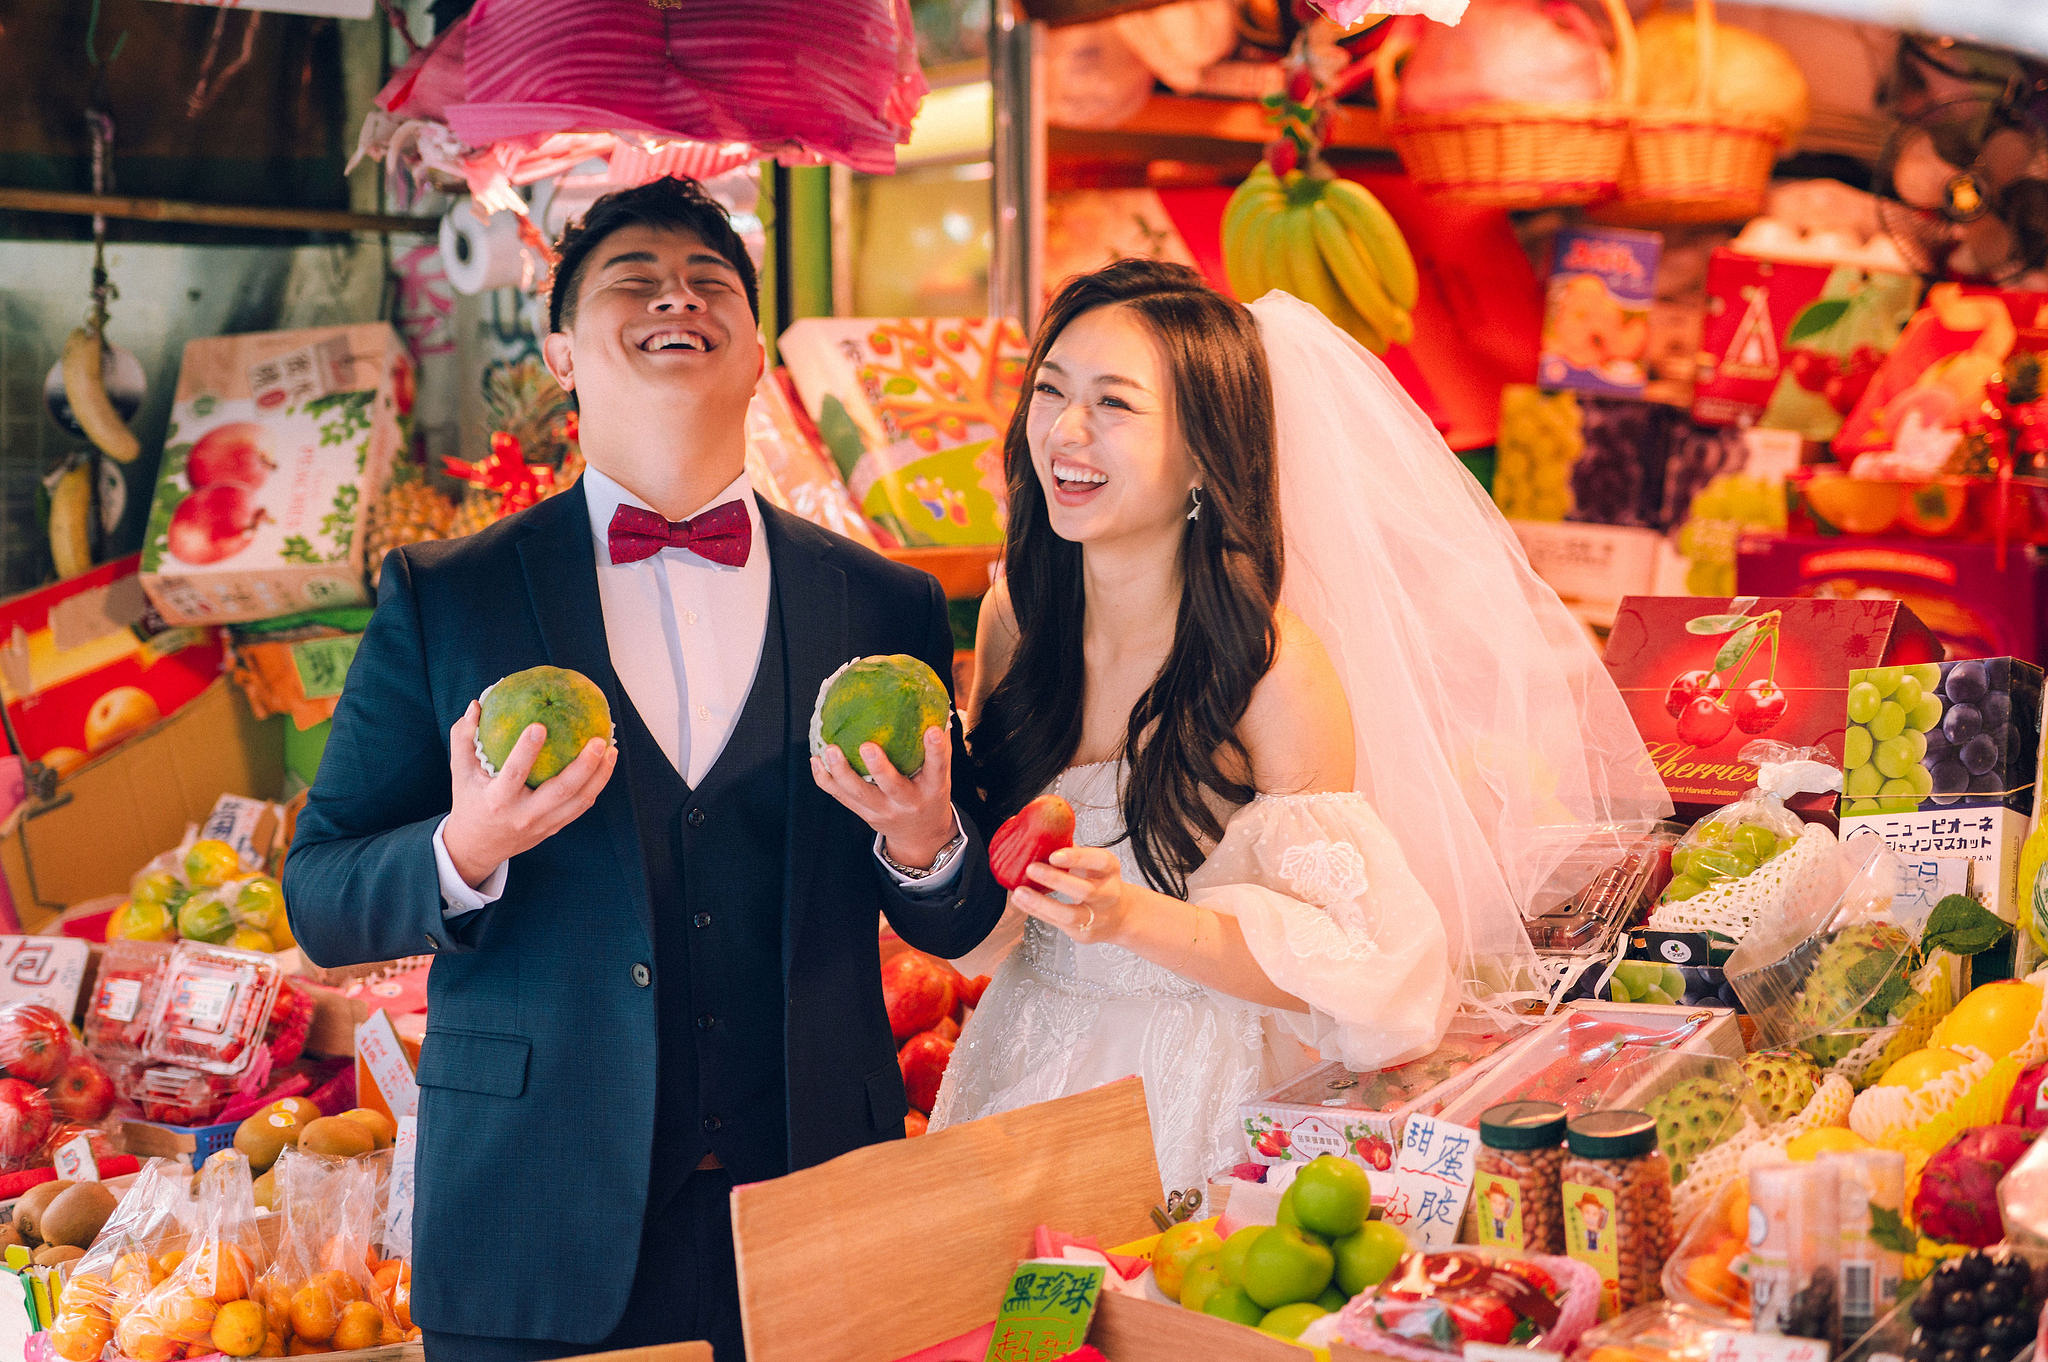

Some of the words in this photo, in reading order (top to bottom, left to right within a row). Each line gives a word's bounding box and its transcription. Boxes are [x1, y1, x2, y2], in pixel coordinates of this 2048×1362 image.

[1685, 785, 1712, 796] Harvest
[1713, 787, 1739, 797] Season
[1886, 816, 1994, 838] ニューピオーネ
[1406, 1121, 1470, 1182] 甜蜜
[1003, 1271, 1097, 1314] 黑珍珠
